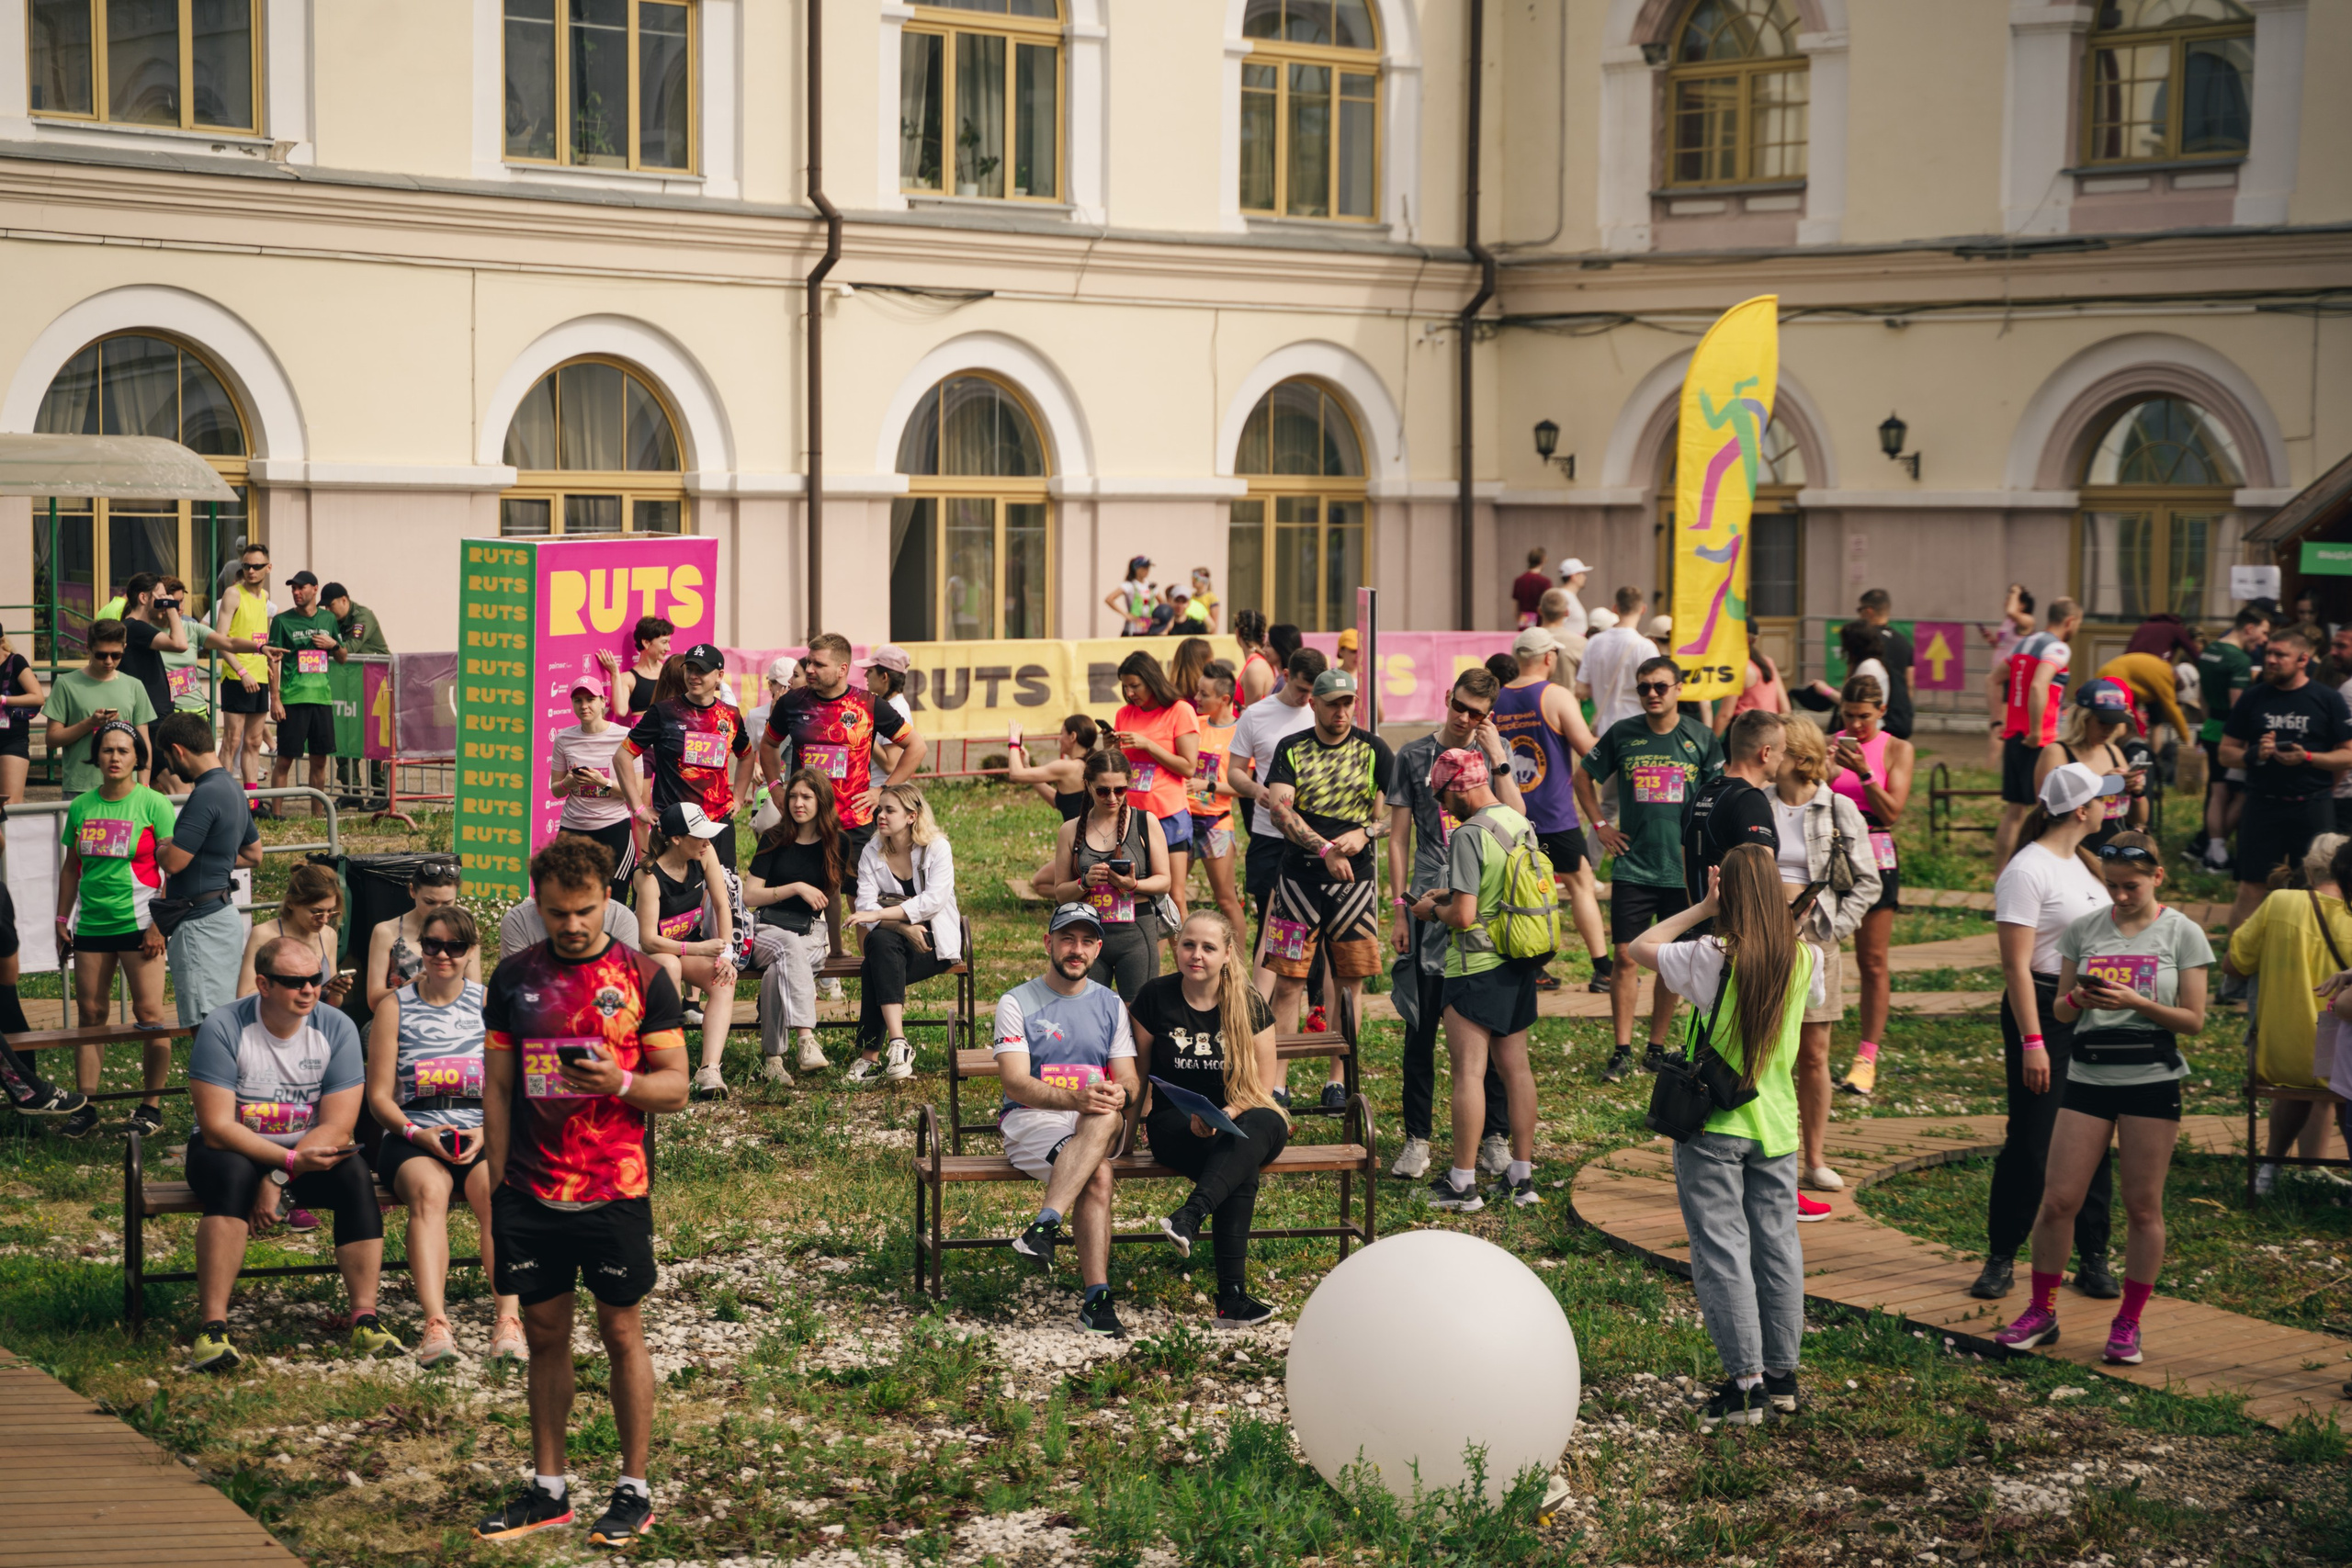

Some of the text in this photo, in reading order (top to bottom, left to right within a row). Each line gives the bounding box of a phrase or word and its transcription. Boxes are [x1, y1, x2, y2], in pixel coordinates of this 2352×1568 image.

[469, 547, 528, 566] RUTS
[469, 575, 528, 593] RUTS
[549, 564, 704, 637] RUTS
[468, 603, 527, 622] RUTS
[467, 630, 526, 649] RUTS
[300, 655, 320, 664] 004
[467, 659, 526, 677] RUTS
[466, 686, 526, 705] RUTS
[905, 664, 1051, 712] RUTS
[465, 714, 526, 733] RUTS
[464, 742, 525, 761] RUTS
[685, 739, 711, 752] 287
[804, 752, 830, 764] 277
[463, 770, 524, 789] RUTS
[1635, 776, 1661, 788] 213
[462, 797, 523, 817] RUTS
[82, 828, 107, 840] 129
[461, 825, 522, 844] RUTS
[461, 852, 521, 872] RUTS
[460, 881, 521, 899] RUTS
[662, 920, 689, 938] 095
[1268, 926, 1284, 942] 154
[525, 1055, 563, 1075] 23
[1174, 1057, 1200, 1070] YOGA
[417, 1068, 459, 1085] 240
[1043, 1076, 1080, 1090] 293
[274, 1088, 310, 1102] RUN
[243, 1103, 279, 1117] 241
